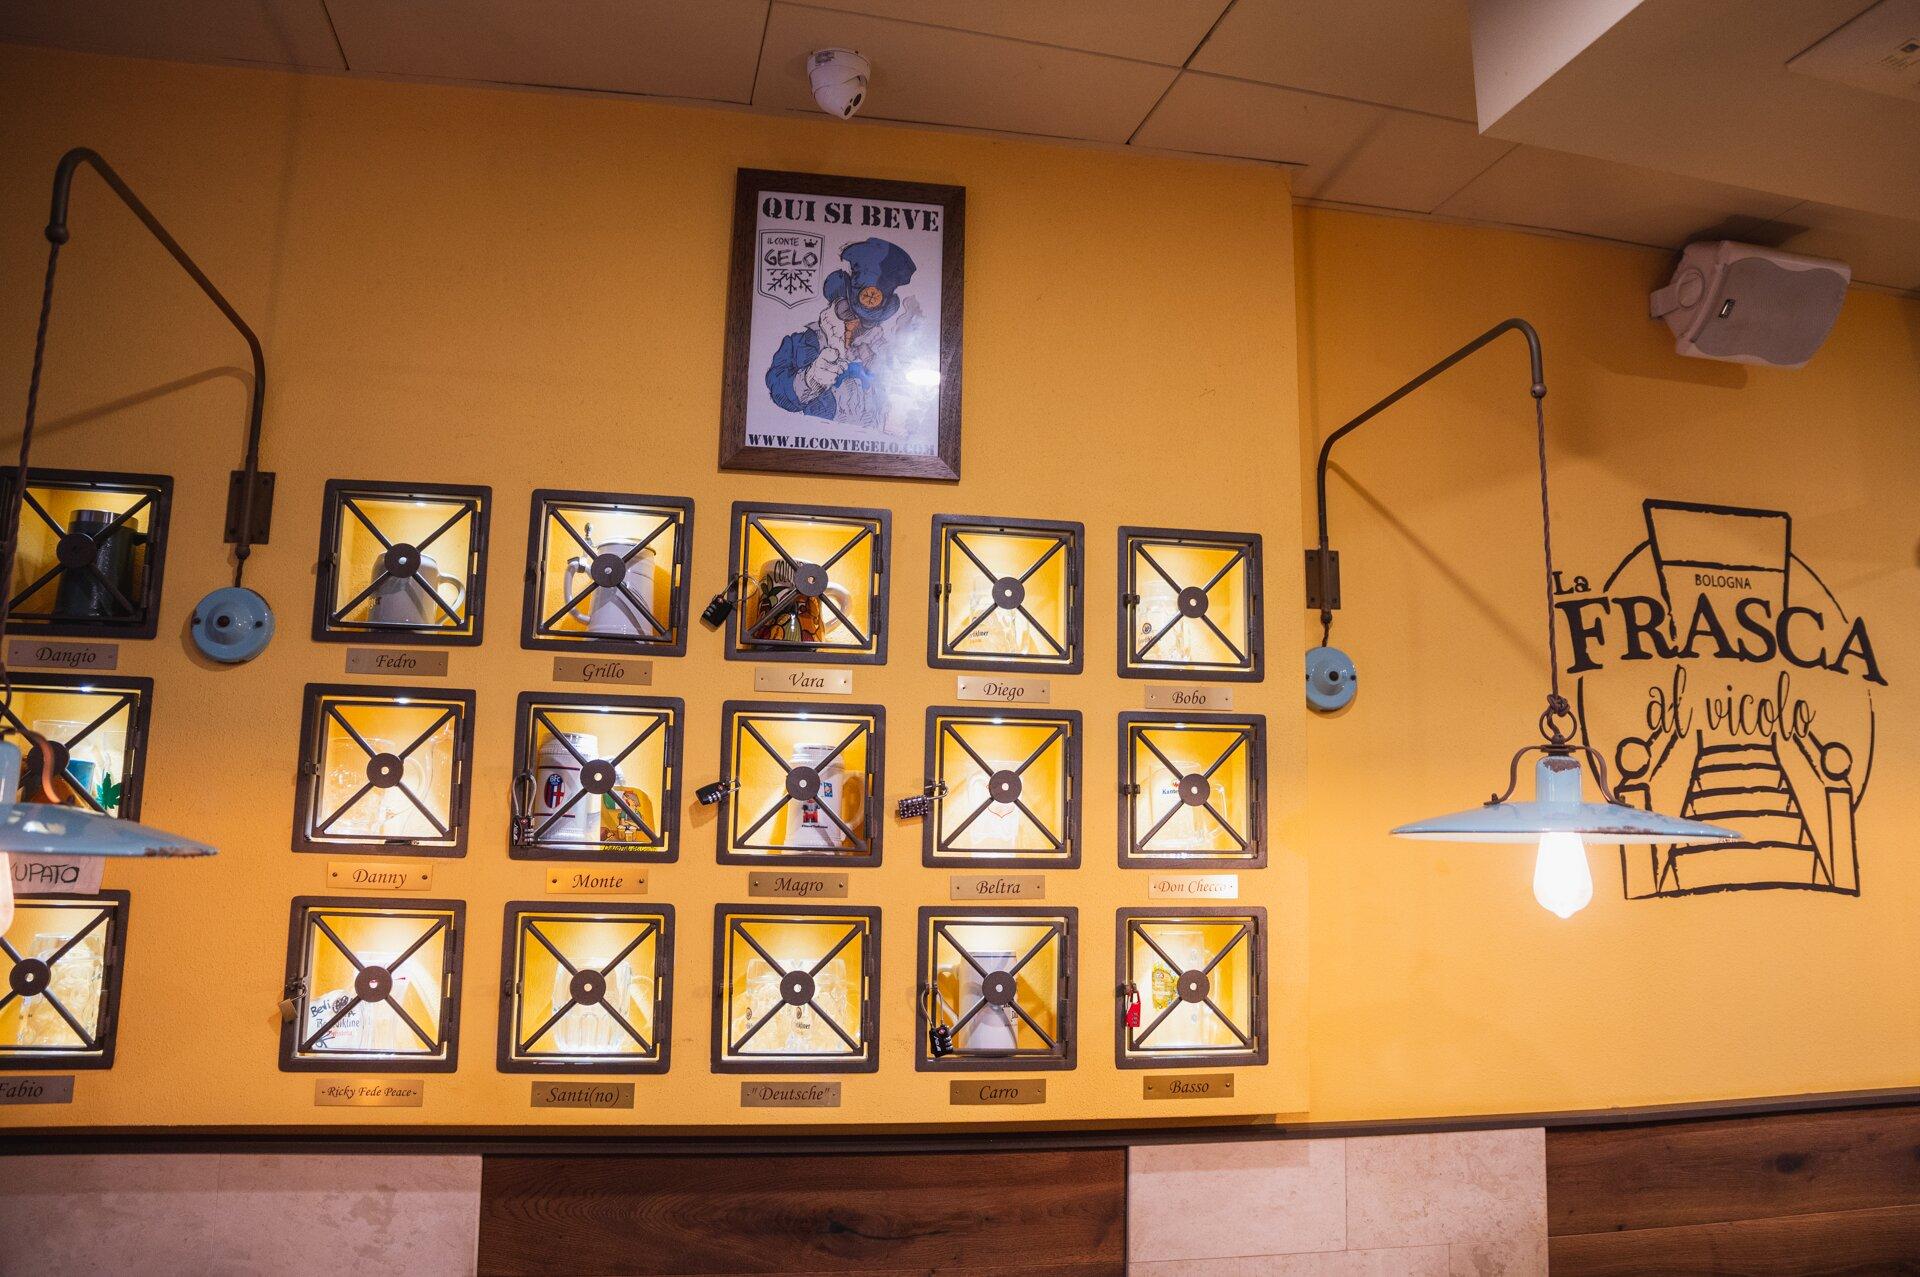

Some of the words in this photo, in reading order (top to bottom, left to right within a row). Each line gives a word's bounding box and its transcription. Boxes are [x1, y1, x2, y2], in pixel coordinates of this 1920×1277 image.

[762, 197, 816, 223] QUI
[824, 202, 853, 225] SI
[861, 204, 939, 232] BEVE
[764, 249, 818, 268] GELO
[1552, 571, 1591, 595] La
[1695, 574, 1752, 590] BOLOGNA
[1555, 592, 1889, 686] FRASCA
[35, 646, 97, 667] Dangio
[376, 653, 417, 670] Fedro
[582, 663, 625, 681] Grillo
[789, 672, 825, 689] Vara
[983, 683, 1025, 701] Diego
[1172, 690, 1207, 705] Bobo
[1646, 664, 1693, 739] al
[1706, 671, 1816, 742] vicolo
[352, 868, 407, 889] Danny
[572, 874, 623, 889] Monte
[774, 877, 824, 896] Magro
[976, 879, 1021, 895] Beltra
[1158, 880, 1184, 893] Don
[327, 1085, 356, 1099] Ricky
[359, 1085, 381, 1097] Fede
[384, 1086, 412, 1097] Peace
[751, 1086, 830, 1101] "Deutsche"
[979, 1085, 1019, 1101] Carro
[1169, 1080, 1210, 1094] Basso
[546, 1086, 620, 1107] Santi(no)
